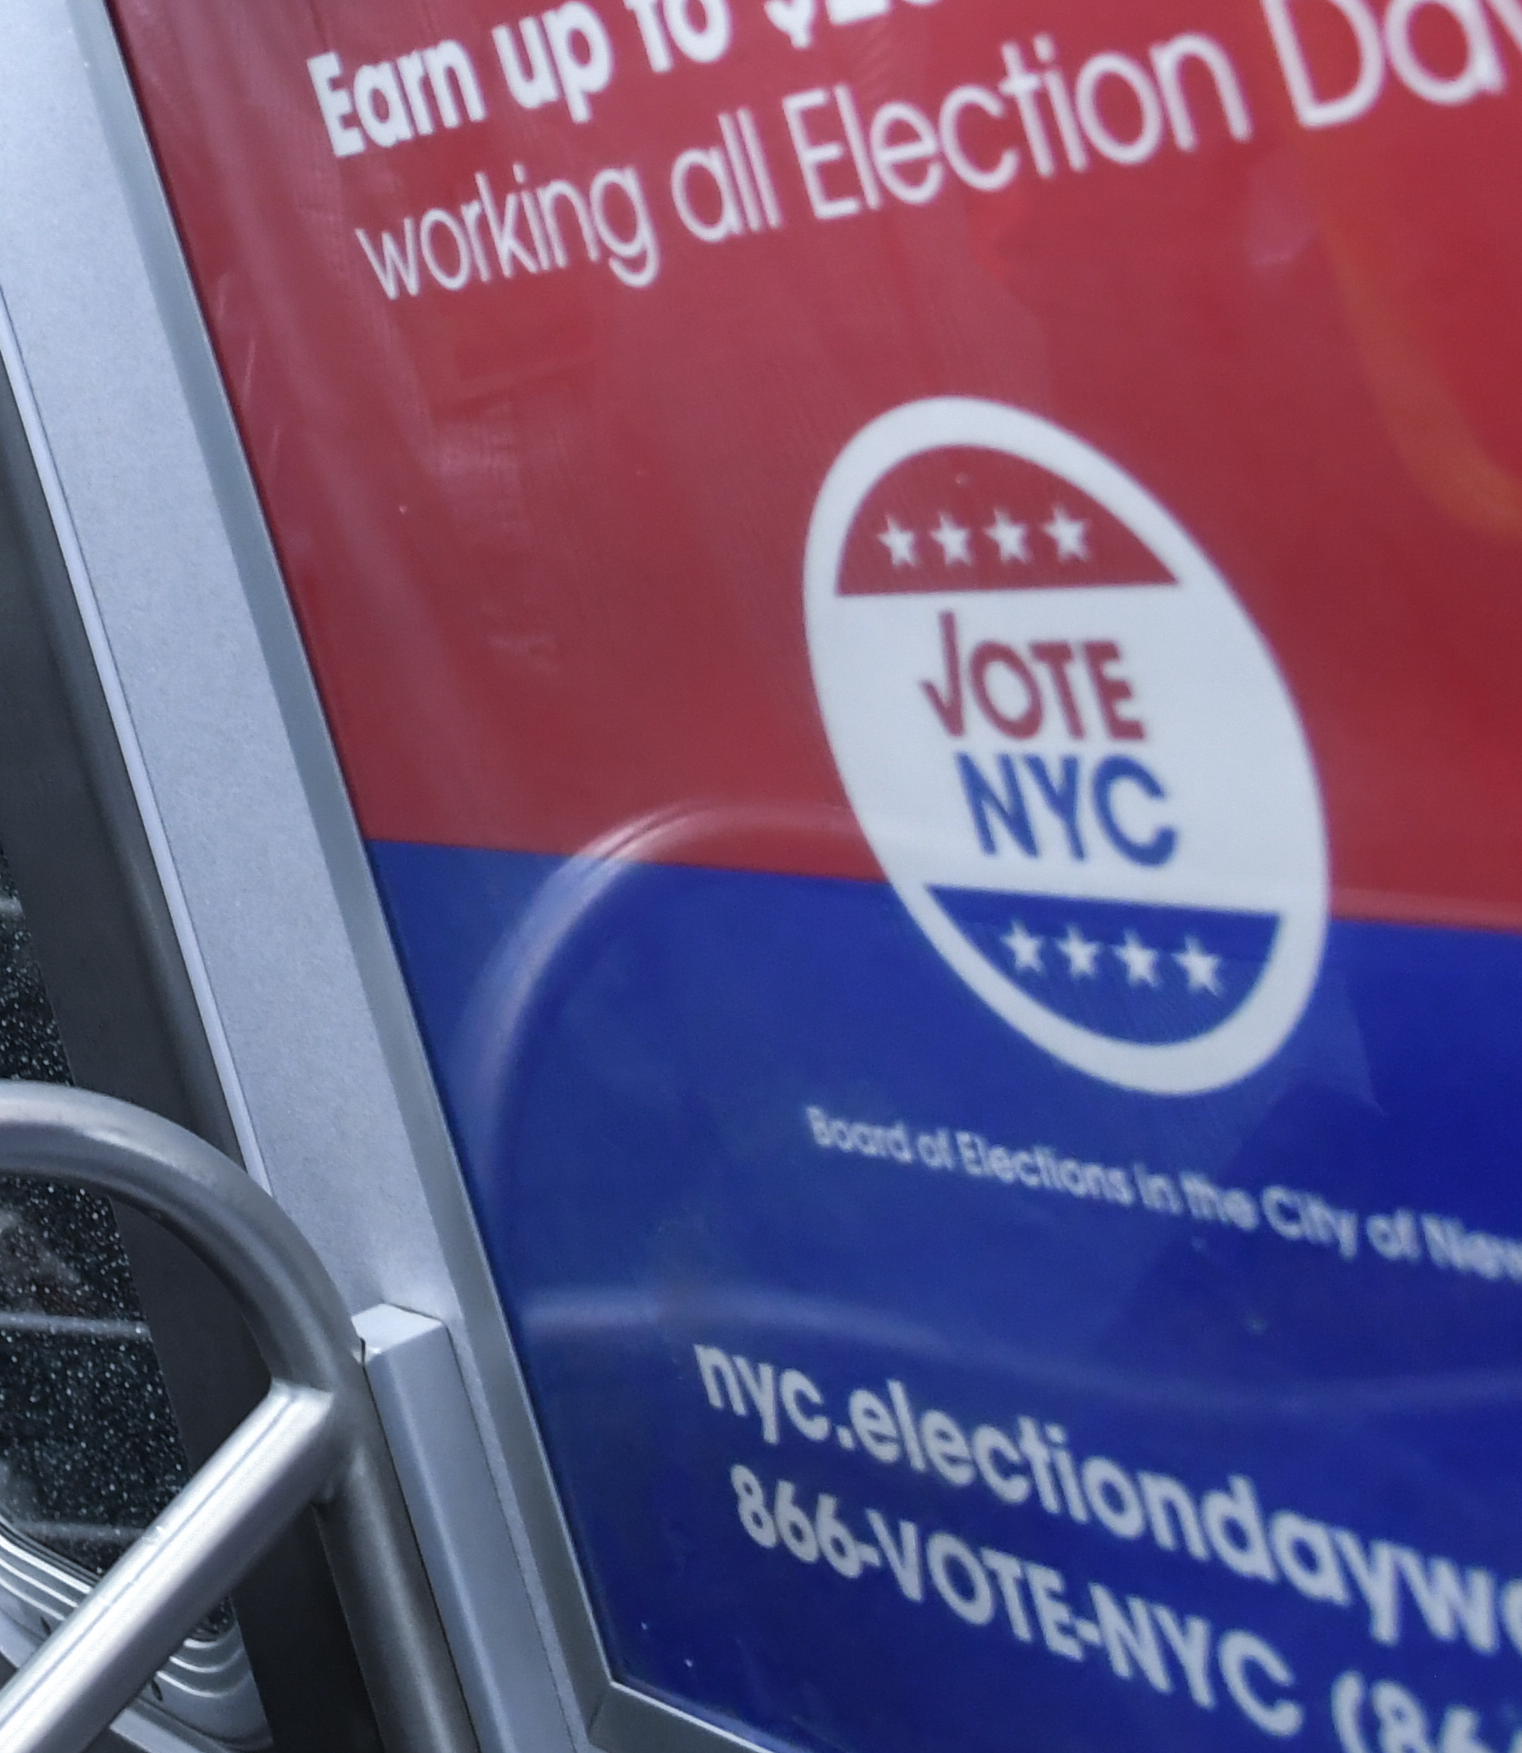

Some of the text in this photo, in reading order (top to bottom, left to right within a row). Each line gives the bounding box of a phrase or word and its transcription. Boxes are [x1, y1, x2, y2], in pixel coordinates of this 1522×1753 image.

[306, 39, 486, 159] Earn
[491, 0, 613, 124] up
[353, 166, 661, 302] working
[670, 108, 783, 245] all
[781, 32, 1253, 221] Election
[919, 608, 1148, 742] VOTE
[954, 750, 1180, 869] NYC
[805, 1105, 913, 1164] Board
[915, 1129, 956, 1173] of
[957, 1131, 1135, 1207] Elections
[1135, 1163, 1182, 1215] in
[1179, 1170, 1259, 1231] the
[1260, 1183, 1359, 1260] City
[1365, 1208, 1421, 1262] of
[730, 1463, 1303, 1737] 866-VOTE-NYC
